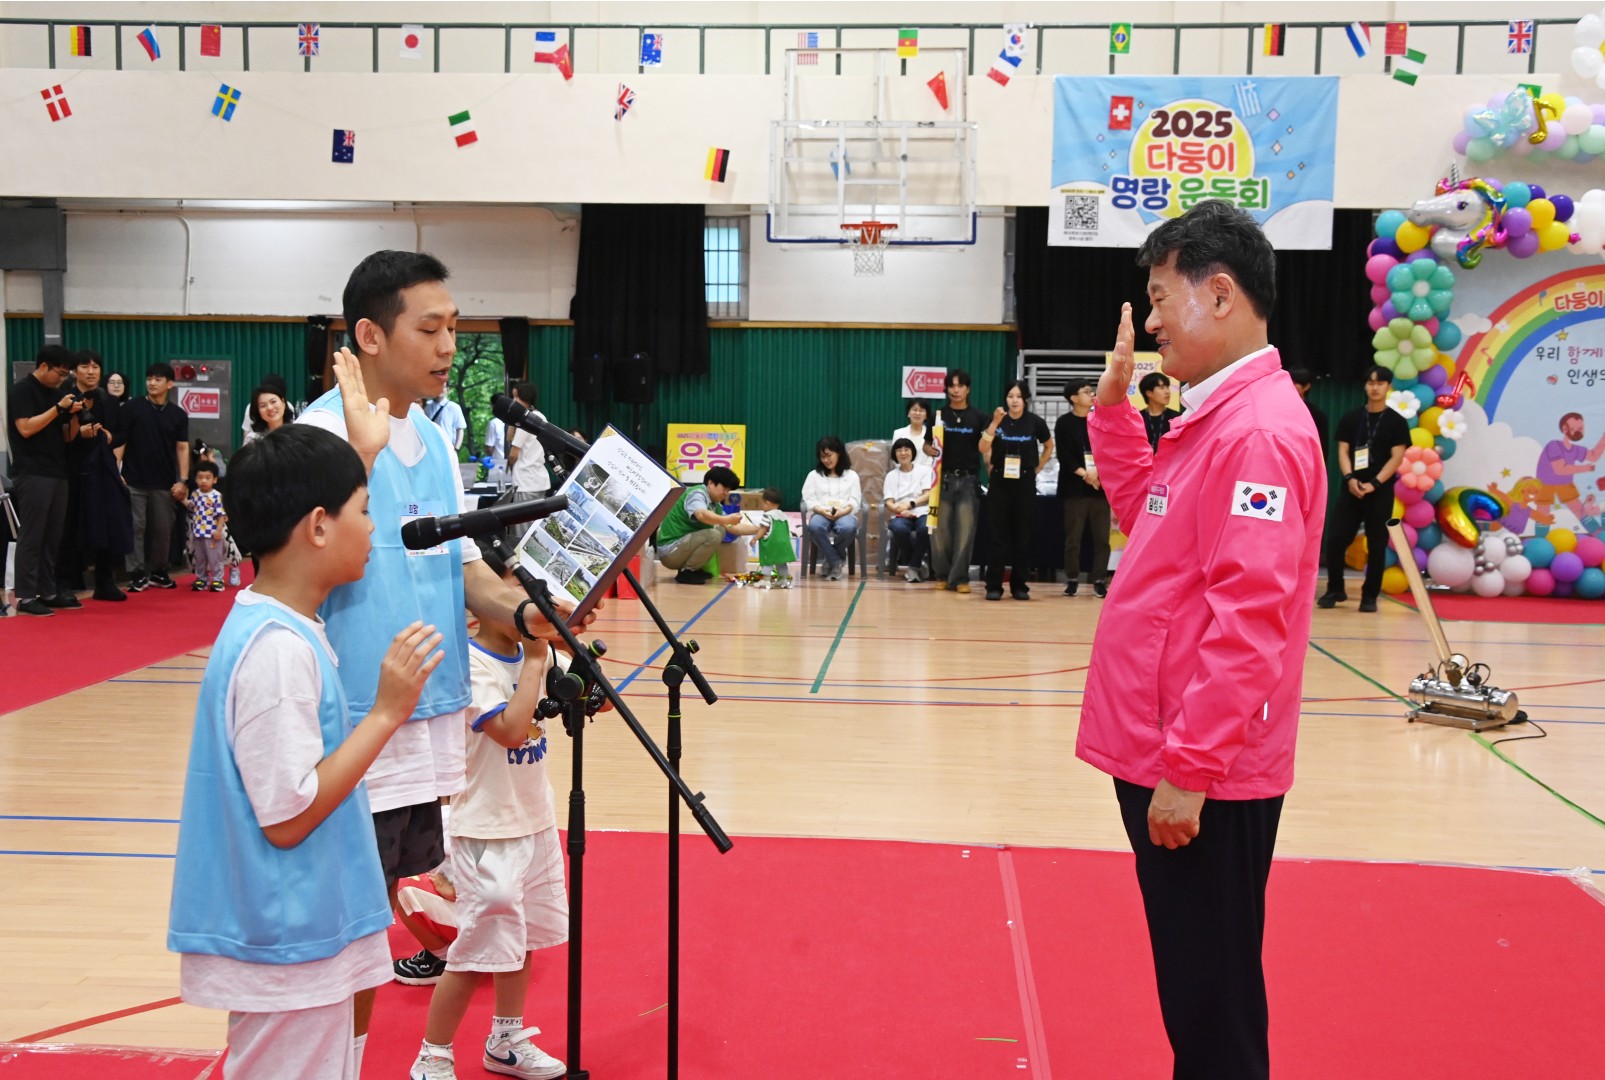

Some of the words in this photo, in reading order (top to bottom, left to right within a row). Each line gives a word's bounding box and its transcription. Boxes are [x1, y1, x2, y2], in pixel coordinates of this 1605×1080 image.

[1151, 110, 1233, 138] 2025
[1147, 141, 1235, 175] 다둥이
[1112, 176, 1172, 210] 명랑
[1554, 289, 1604, 312] 다둥이
[1536, 346, 1560, 361] 우리
[678, 442, 733, 470] 우승
